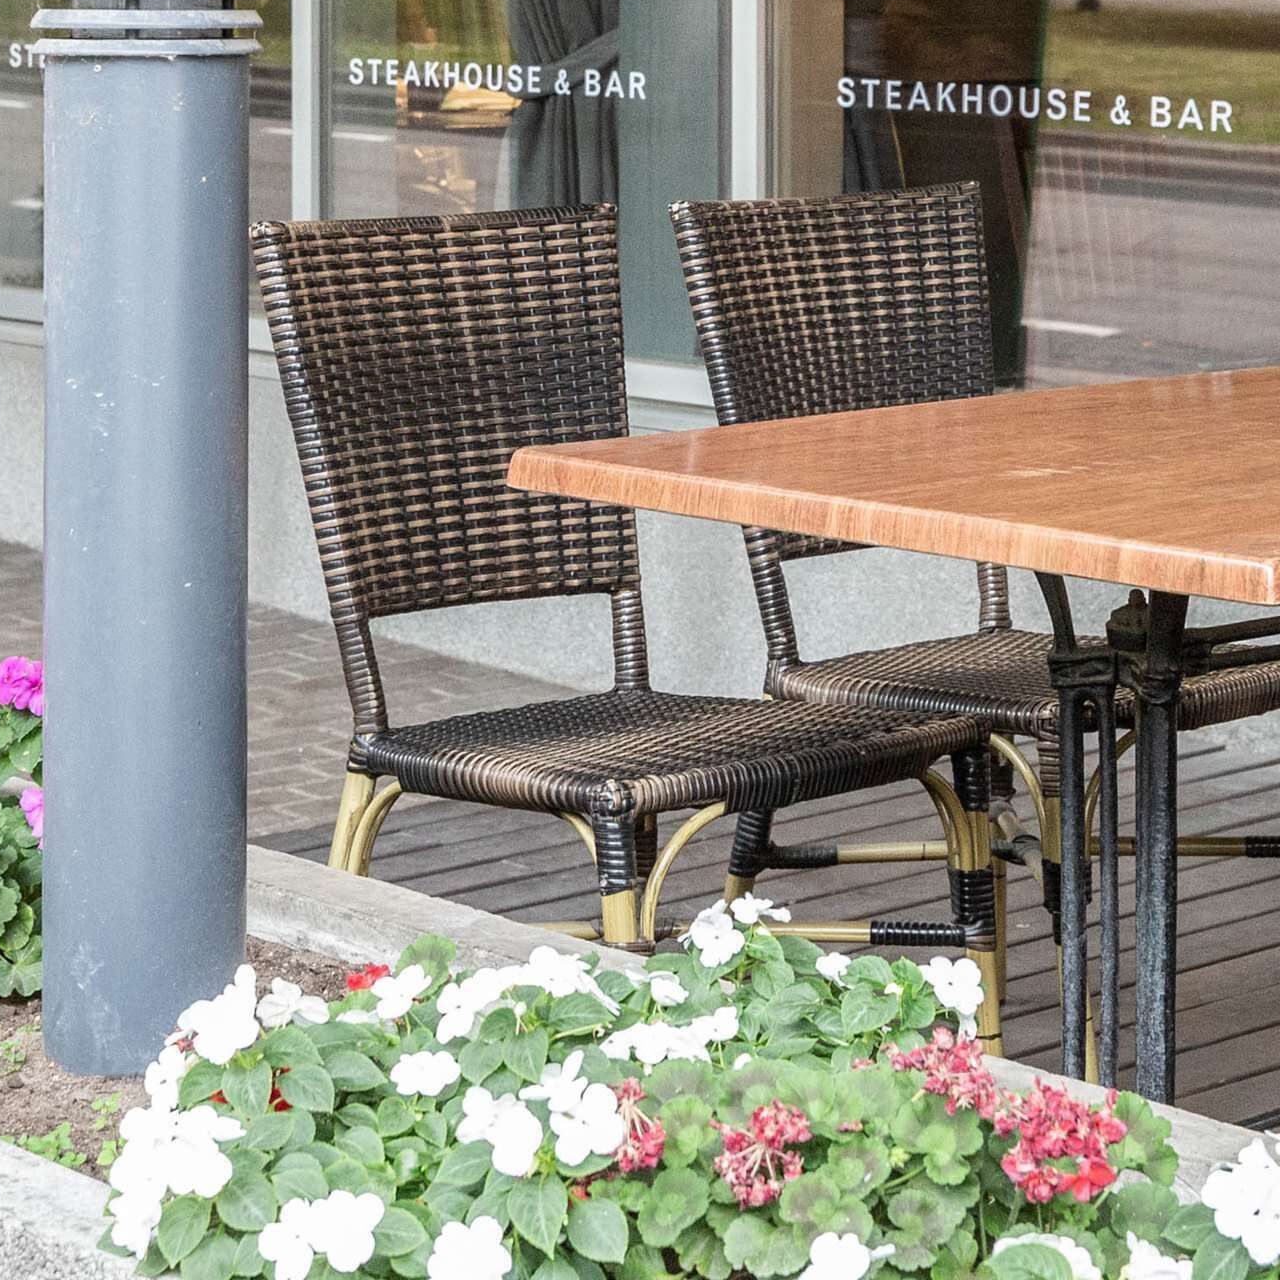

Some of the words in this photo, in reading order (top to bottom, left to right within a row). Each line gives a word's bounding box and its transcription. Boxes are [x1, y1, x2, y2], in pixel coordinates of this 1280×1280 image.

[348, 57, 542, 94] STEAKHOUSE
[554, 68, 572, 96] &
[584, 68, 648, 101] BAR
[835, 76, 1093, 123] STEAKHOUSE
[1109, 94, 1133, 126] &
[1150, 95, 1234, 134] BAR
